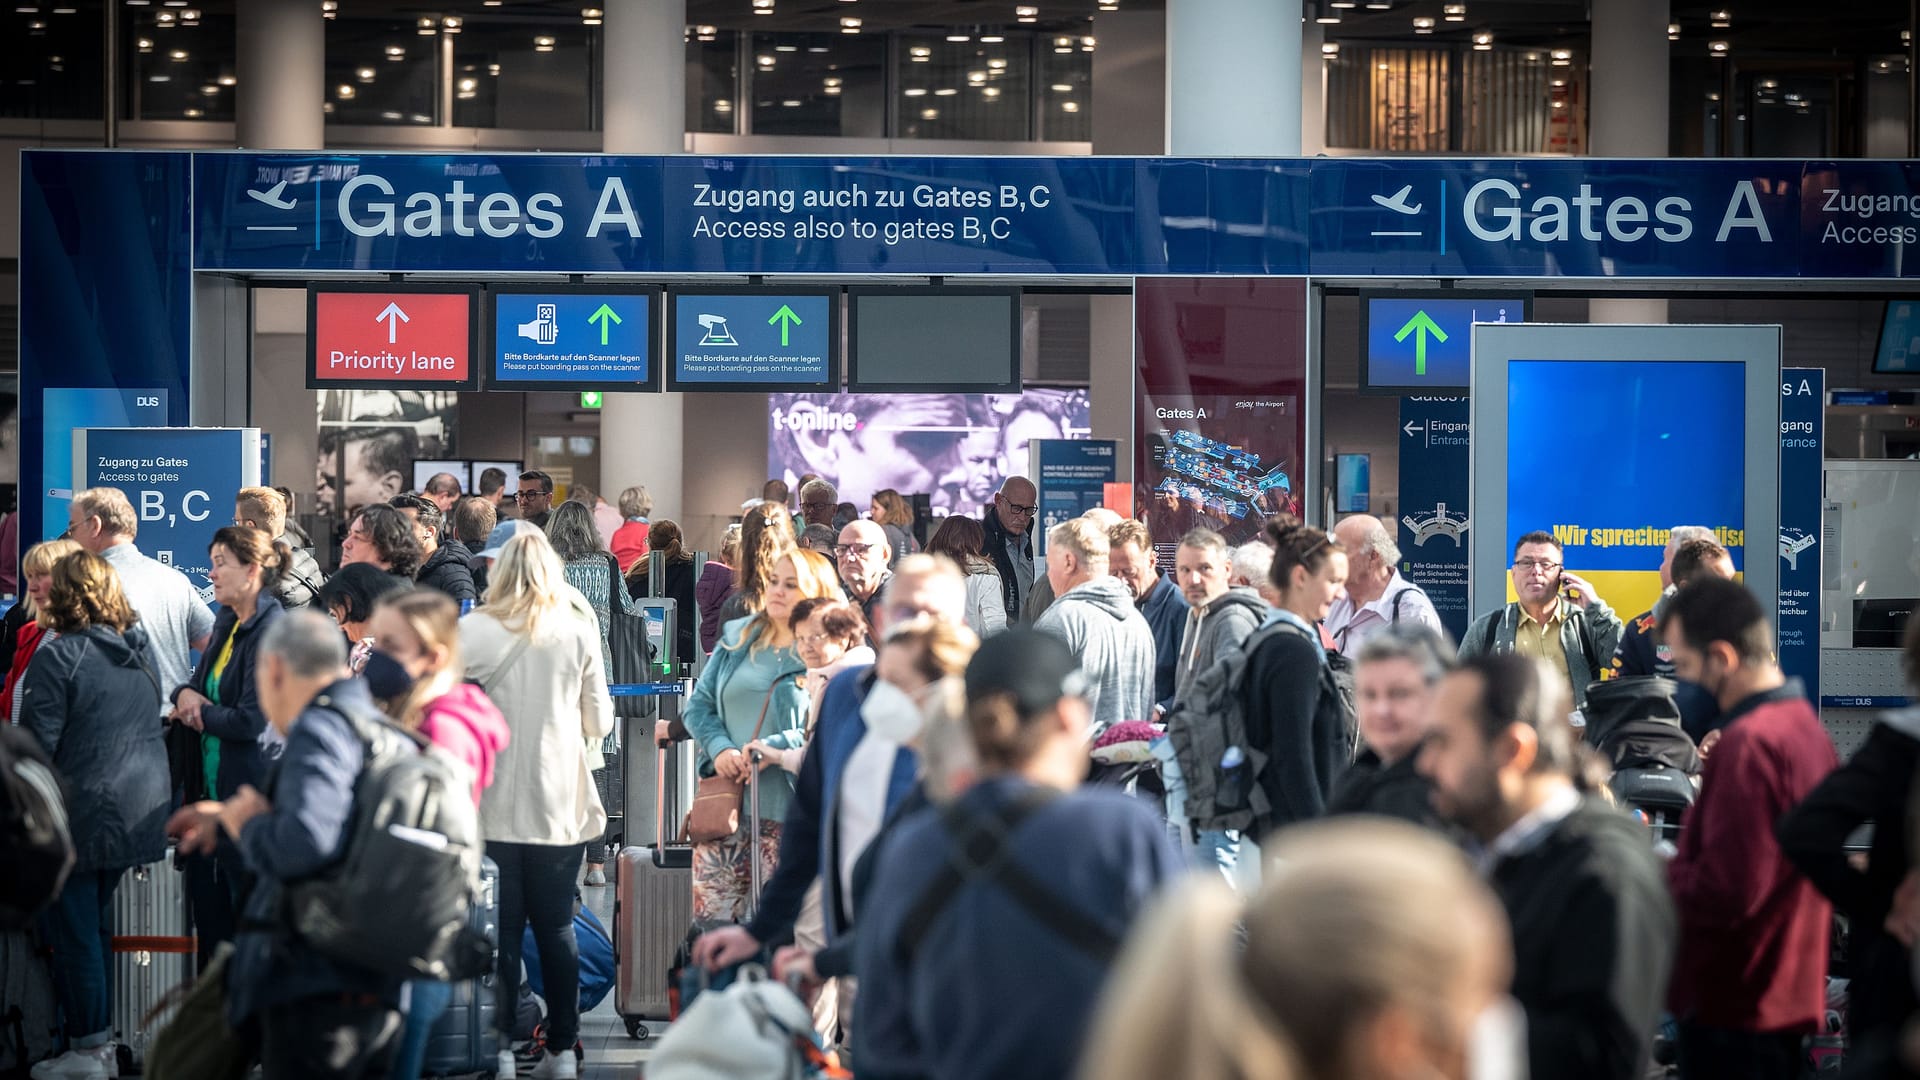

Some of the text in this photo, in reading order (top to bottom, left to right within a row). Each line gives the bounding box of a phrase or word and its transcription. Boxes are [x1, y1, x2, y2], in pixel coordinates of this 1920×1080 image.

[693, 184, 794, 212] Zugang
[804, 184, 866, 208] auch
[875, 189, 904, 208] zu
[912, 184, 992, 208] Gates
[1822, 190, 1920, 218] Zugang
[338, 174, 643, 238] Gates A
[1463, 178, 1773, 243] Gates A
[693, 216, 786, 240] Access
[793, 216, 845, 240] also
[852, 219, 878, 240] to
[884, 218, 954, 246] gates
[1822, 220, 1916, 244] Access
[330, 350, 455, 375] Priority lane
[620, 354, 640, 363] legen
[800, 355, 820, 364] legen
[528, 364, 540, 372] put
[540, 363, 572, 372] boarding
[720, 364, 752, 373] boarding
[1797, 379, 1812, 396] A
[136, 396, 159, 407] DUS
[1156, 408, 1206, 418] Gates A
[98, 457, 138, 468] Zugang
[156, 457, 188, 468] Gates
[98, 472, 179, 484] Access to gates
[1553, 524, 1588, 546] Wir
[162, 554, 169, 564] B
